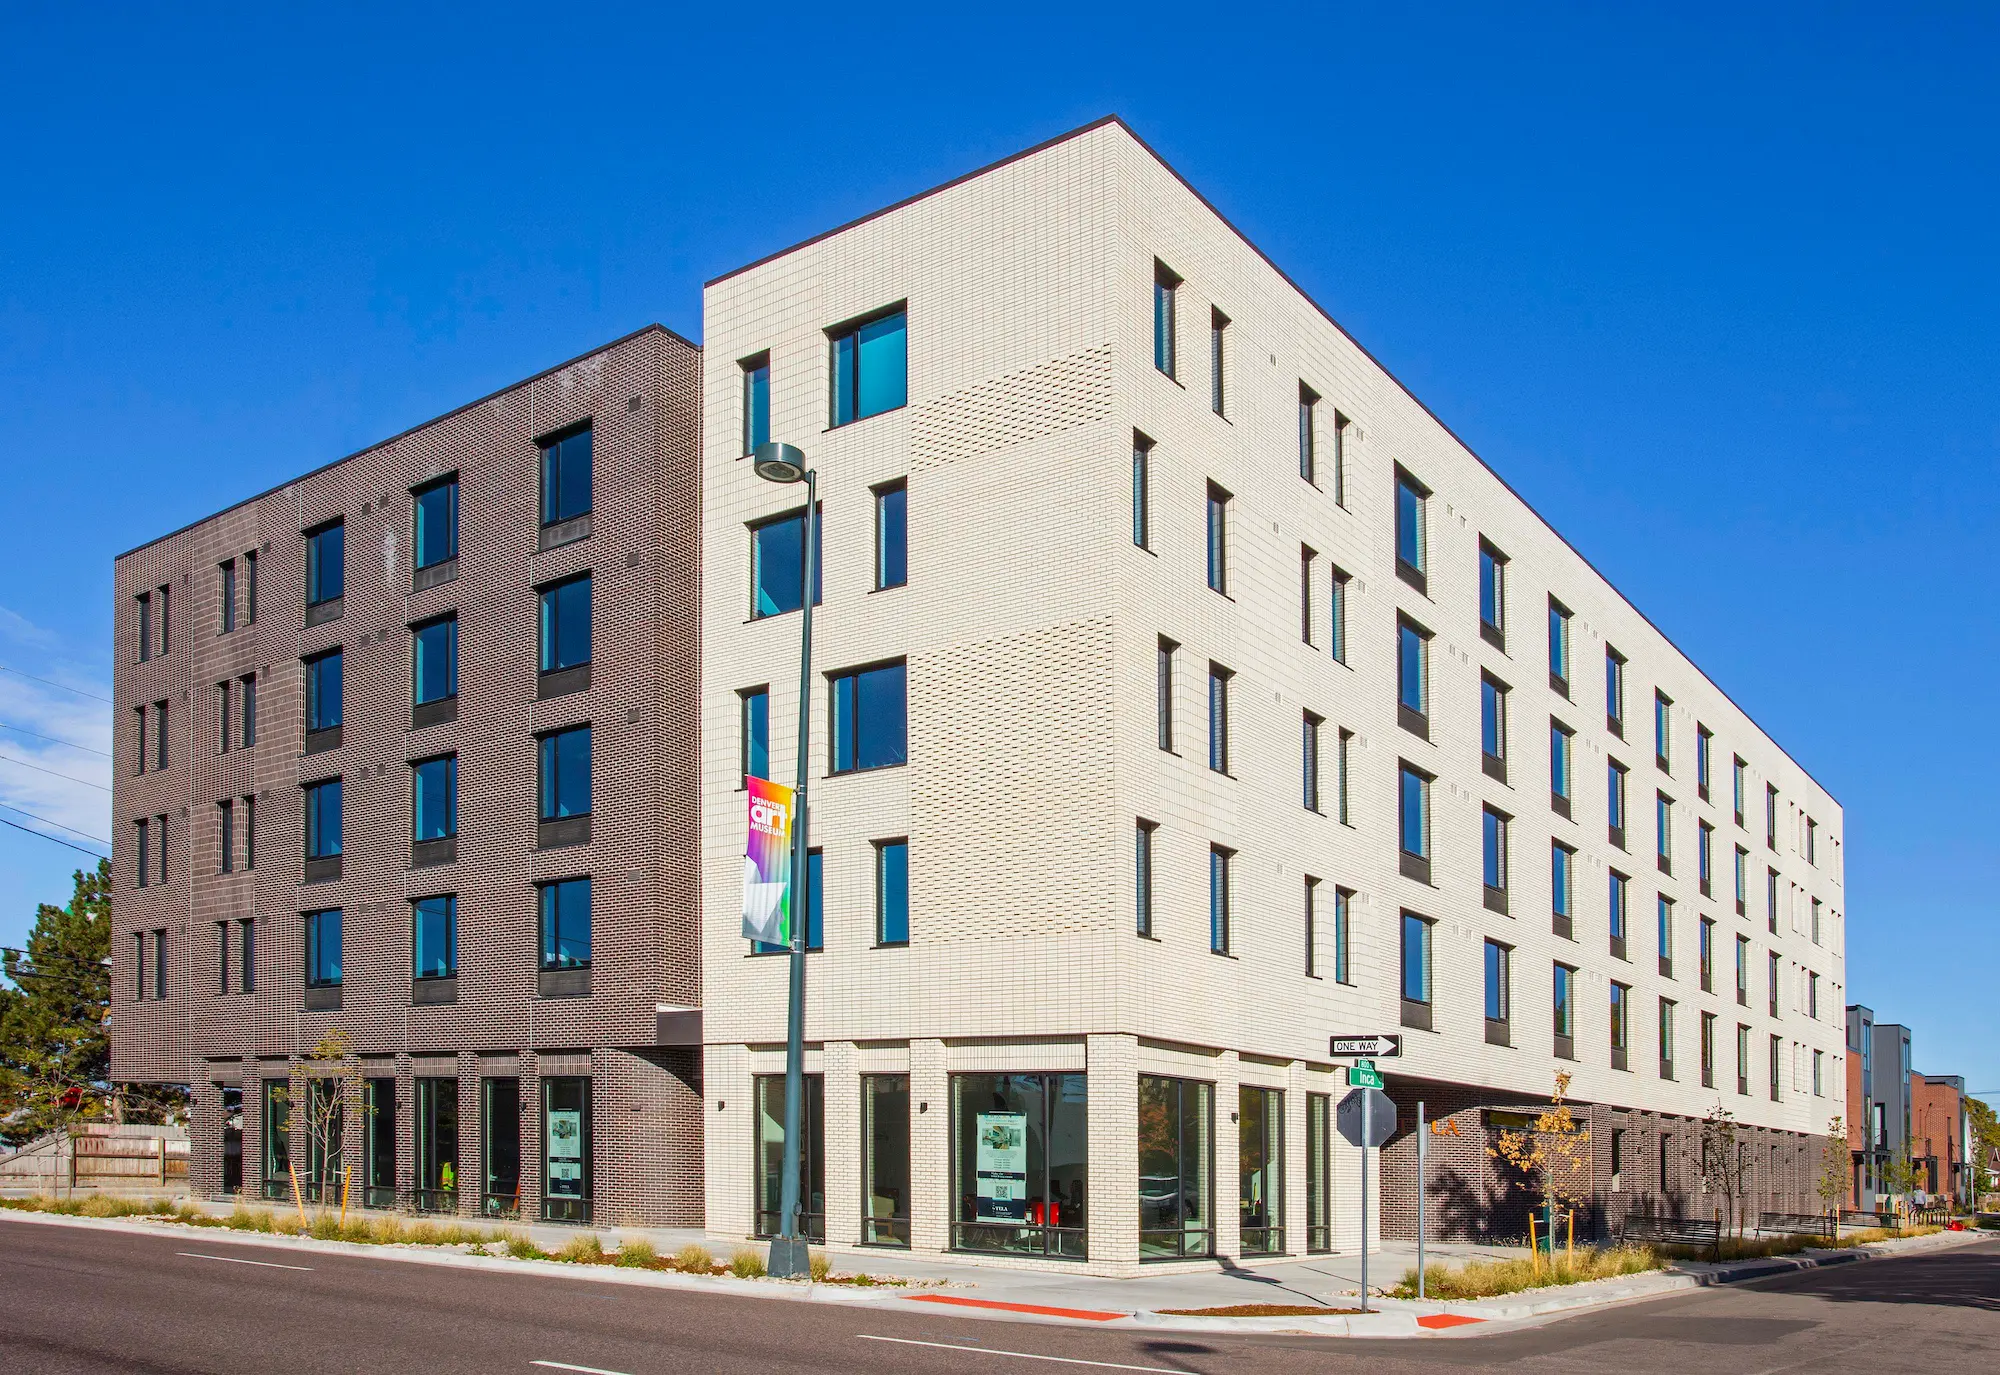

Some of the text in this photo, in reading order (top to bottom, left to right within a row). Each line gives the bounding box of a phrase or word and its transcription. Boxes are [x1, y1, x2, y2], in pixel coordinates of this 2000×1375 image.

[752, 796, 781, 810] DENVER
[751, 804, 787, 829] art
[750, 822, 785, 836] MUSEUM
[1336, 1041, 1378, 1051] ONE WAY
[1360, 1071, 1374, 1085] Inca
